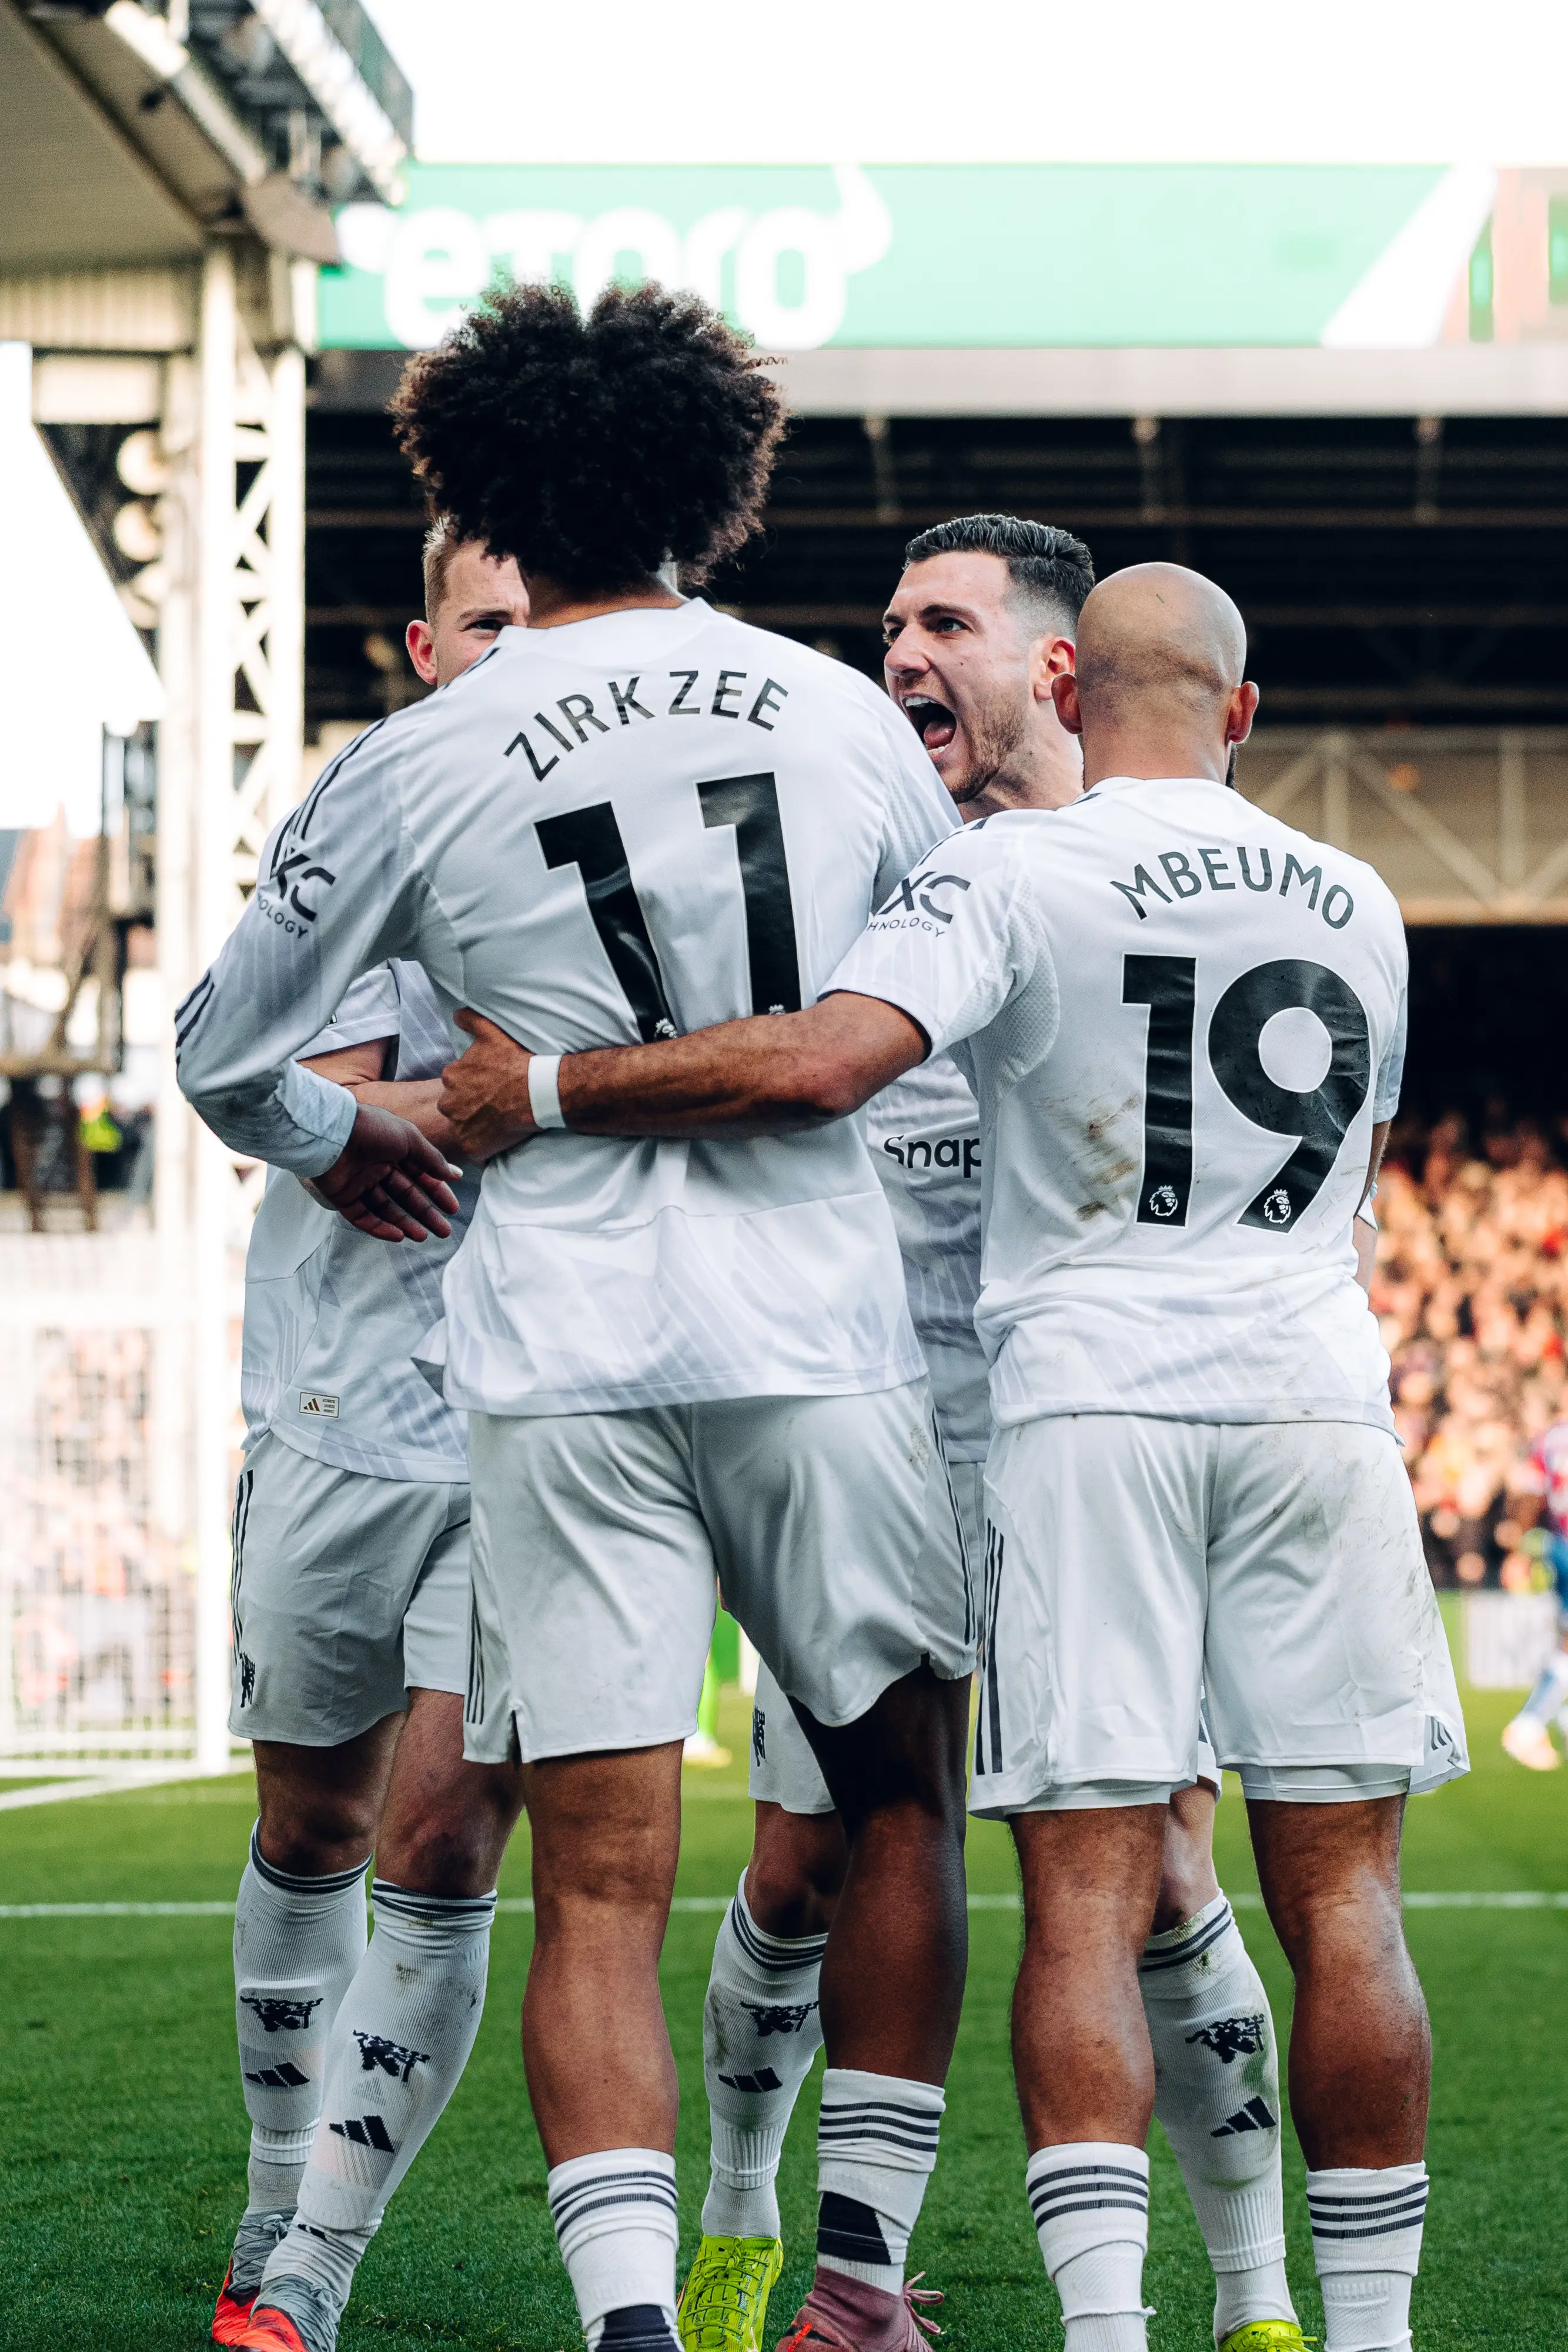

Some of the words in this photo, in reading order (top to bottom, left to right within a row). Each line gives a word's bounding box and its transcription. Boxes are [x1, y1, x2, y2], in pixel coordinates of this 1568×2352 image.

[503, 670, 789, 783] ZIRKZEE
[259, 894, 308, 939] OLOGY
[533, 771, 803, 1044] 11
[877, 871, 971, 924] XC
[1109, 847, 1354, 930] MBEUMO
[867, 917, 945, 938] HNOLOGY
[1121, 953, 1370, 1234] 19
[884, 1134, 982, 1179] Snap
